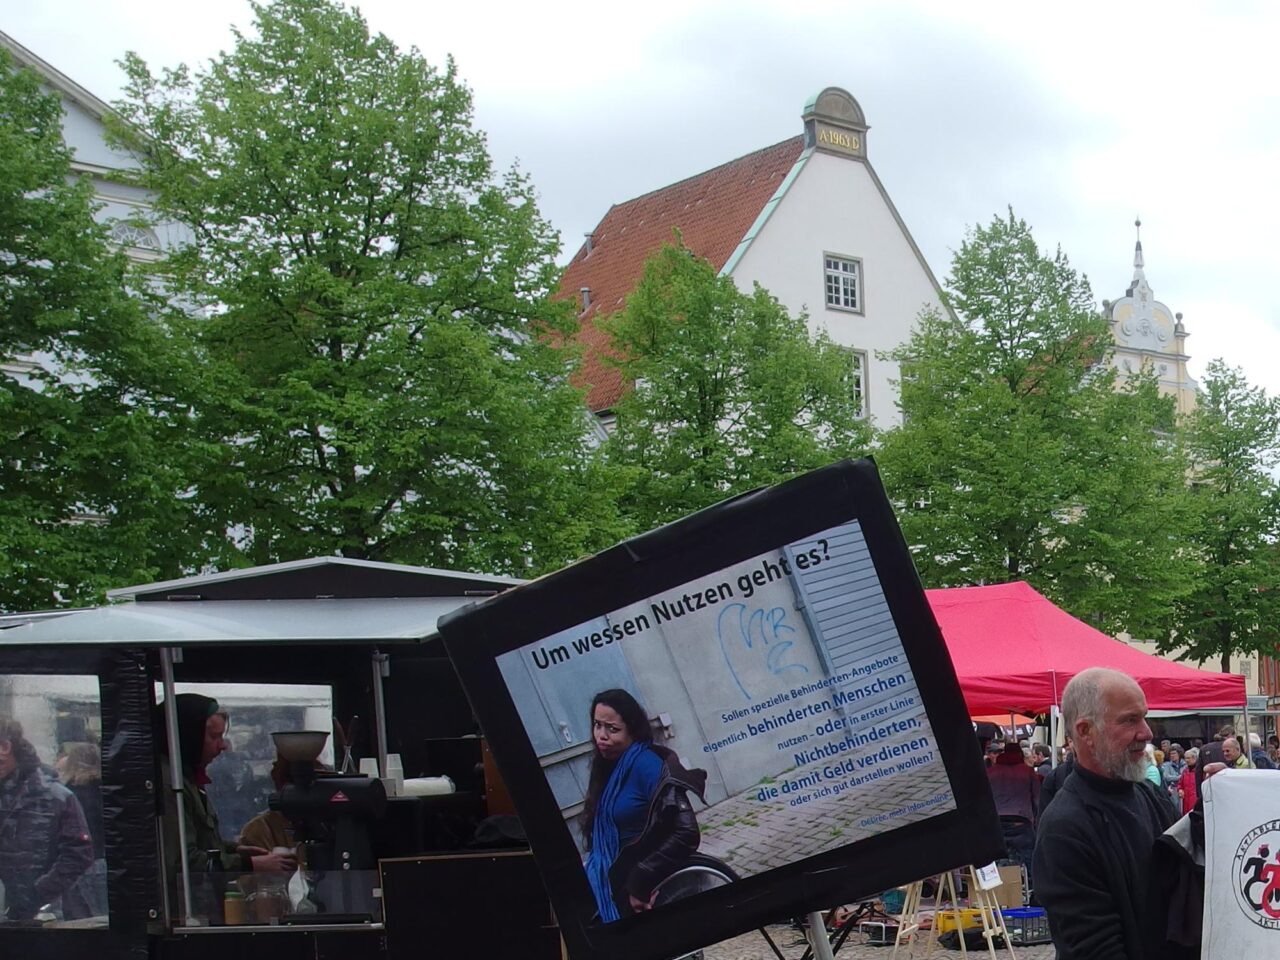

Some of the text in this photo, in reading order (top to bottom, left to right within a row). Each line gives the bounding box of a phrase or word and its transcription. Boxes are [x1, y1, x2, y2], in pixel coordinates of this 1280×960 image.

[532, 539, 831, 669] Um wessen Nutzen geht es?
[703, 673, 906, 753] eigentlich behinderten Menschen
[721, 708, 750, 723] Sollen
[751, 693, 790, 714] spezielle
[790, 655, 899, 700] Behinderten-Angebote
[778, 734, 809, 750] nutzen
[816, 717, 847, 736] oder
[849, 716, 859, 725] in
[861, 706, 888, 721] erster
[890, 697, 914, 711] Linie
[794, 717, 922, 766] Nichtbehinderten,
[758, 736, 929, 802] die damit Geld verdienen
[790, 751, 934, 807] oder sich gut darstellen wollen?
